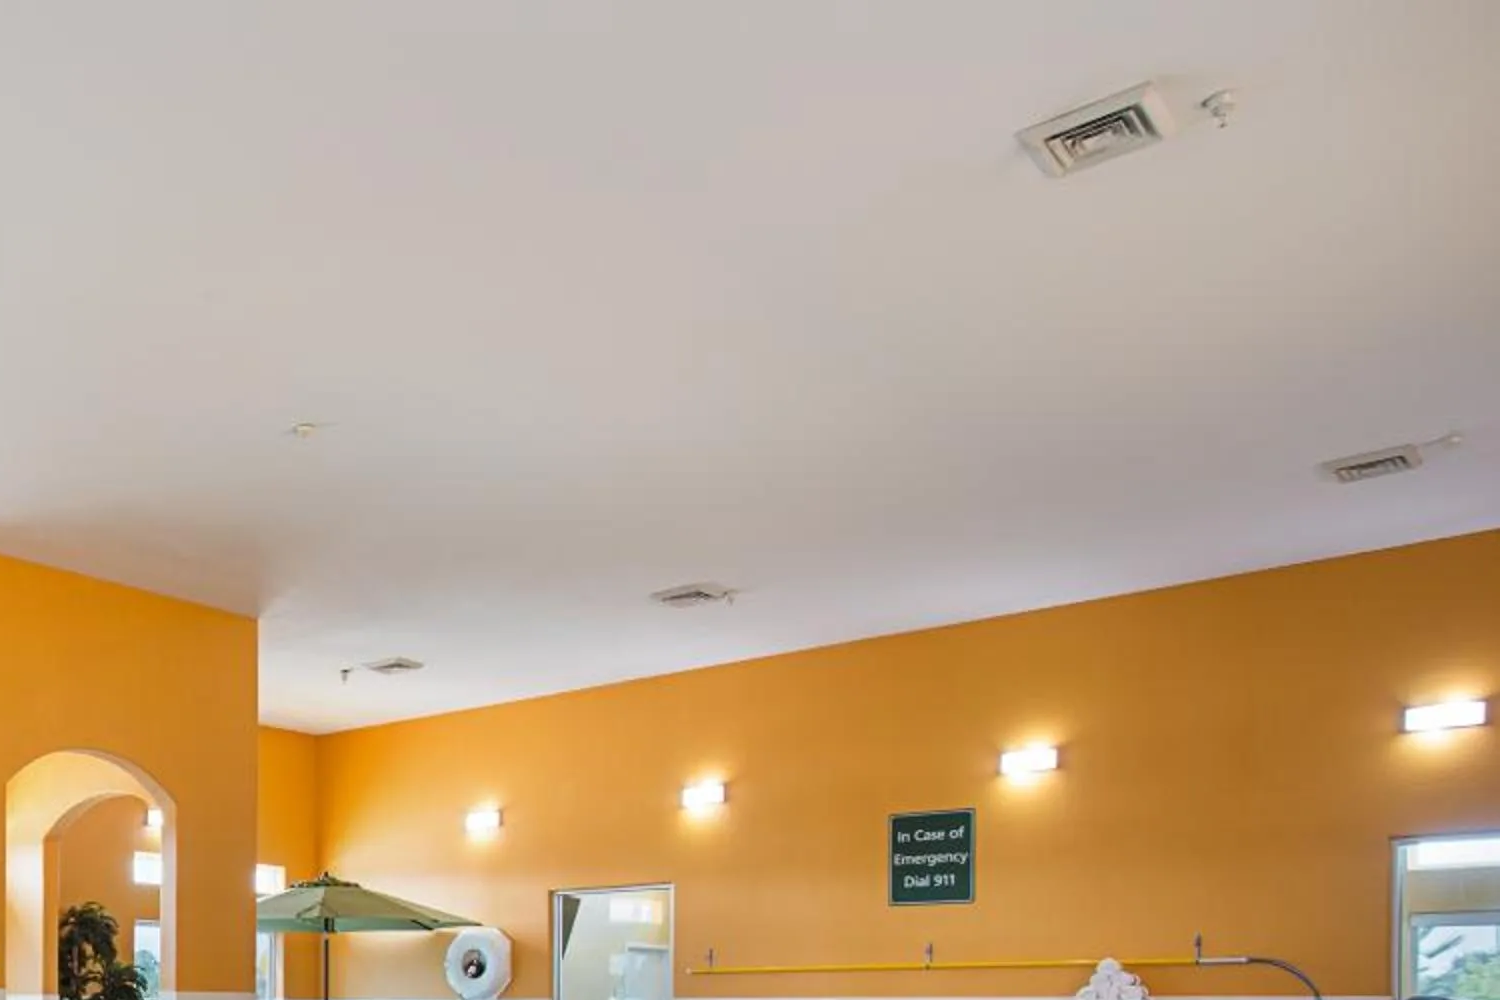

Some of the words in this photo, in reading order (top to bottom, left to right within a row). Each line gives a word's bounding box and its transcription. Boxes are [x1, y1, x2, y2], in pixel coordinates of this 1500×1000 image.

[897, 831, 910, 843] In
[914, 829, 945, 842] Case
[949, 825, 965, 839] of
[893, 851, 969, 867] Emergency
[903, 874, 931, 888] Dial
[933, 873, 956, 887] 911
